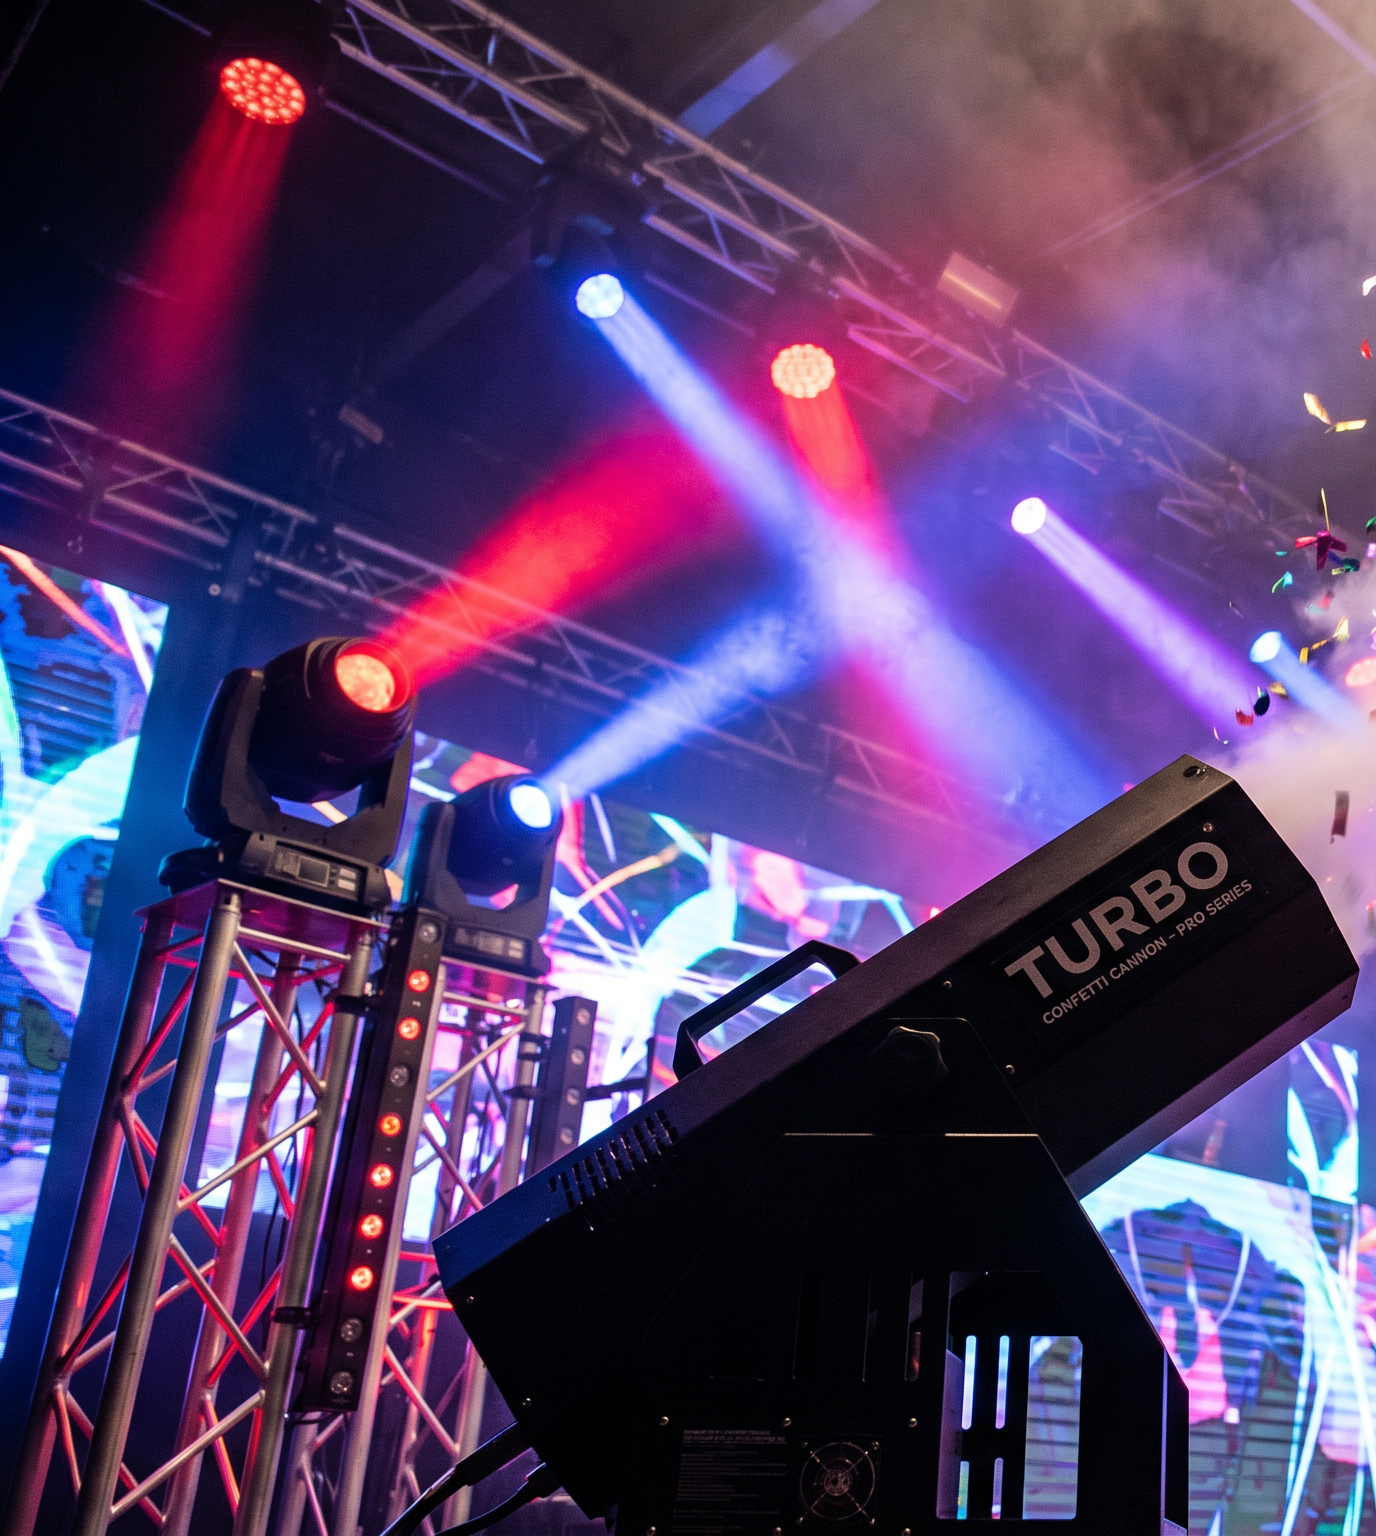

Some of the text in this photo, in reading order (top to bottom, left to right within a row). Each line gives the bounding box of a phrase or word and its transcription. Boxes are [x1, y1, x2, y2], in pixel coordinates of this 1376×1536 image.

[1004, 841, 1229, 999] TURBO
[1042, 975, 1109, 1025] CONFETTI
[1109, 936, 1168, 979] CANNON
[1175, 910, 1206, 938] PRO
[1206, 878, 1253, 915] SERIES
